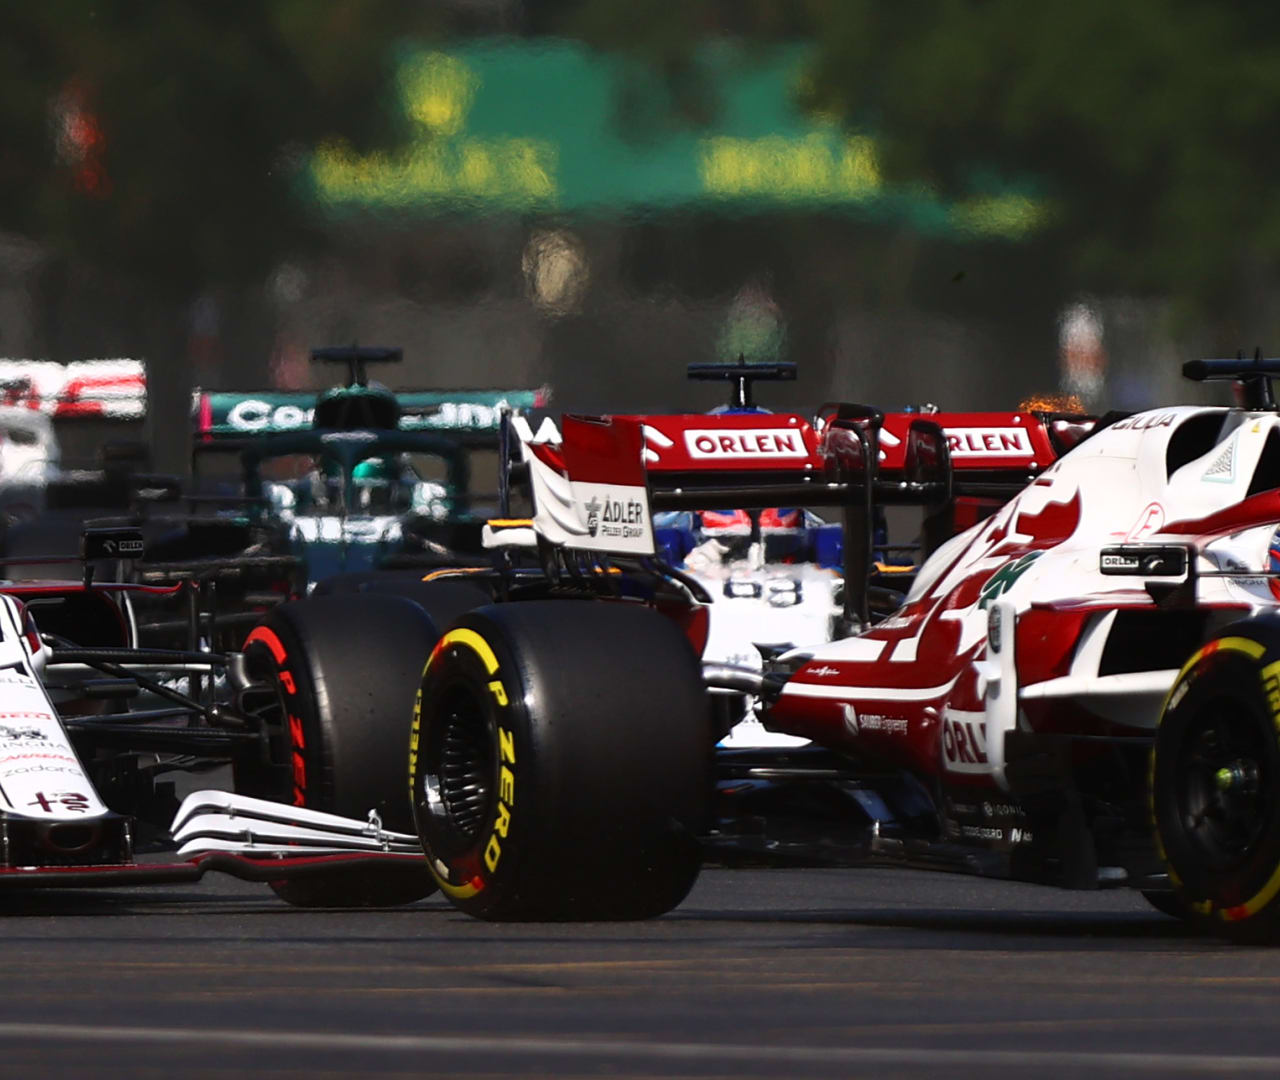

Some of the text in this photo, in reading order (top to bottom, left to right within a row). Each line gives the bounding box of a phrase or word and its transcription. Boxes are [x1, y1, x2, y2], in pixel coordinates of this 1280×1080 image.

[695, 433, 794, 453] ORLEN
[946, 433, 1023, 452] RLEN
[1104, 556, 1137, 566] ORLEN
[485, 681, 516, 873] P ZERO
